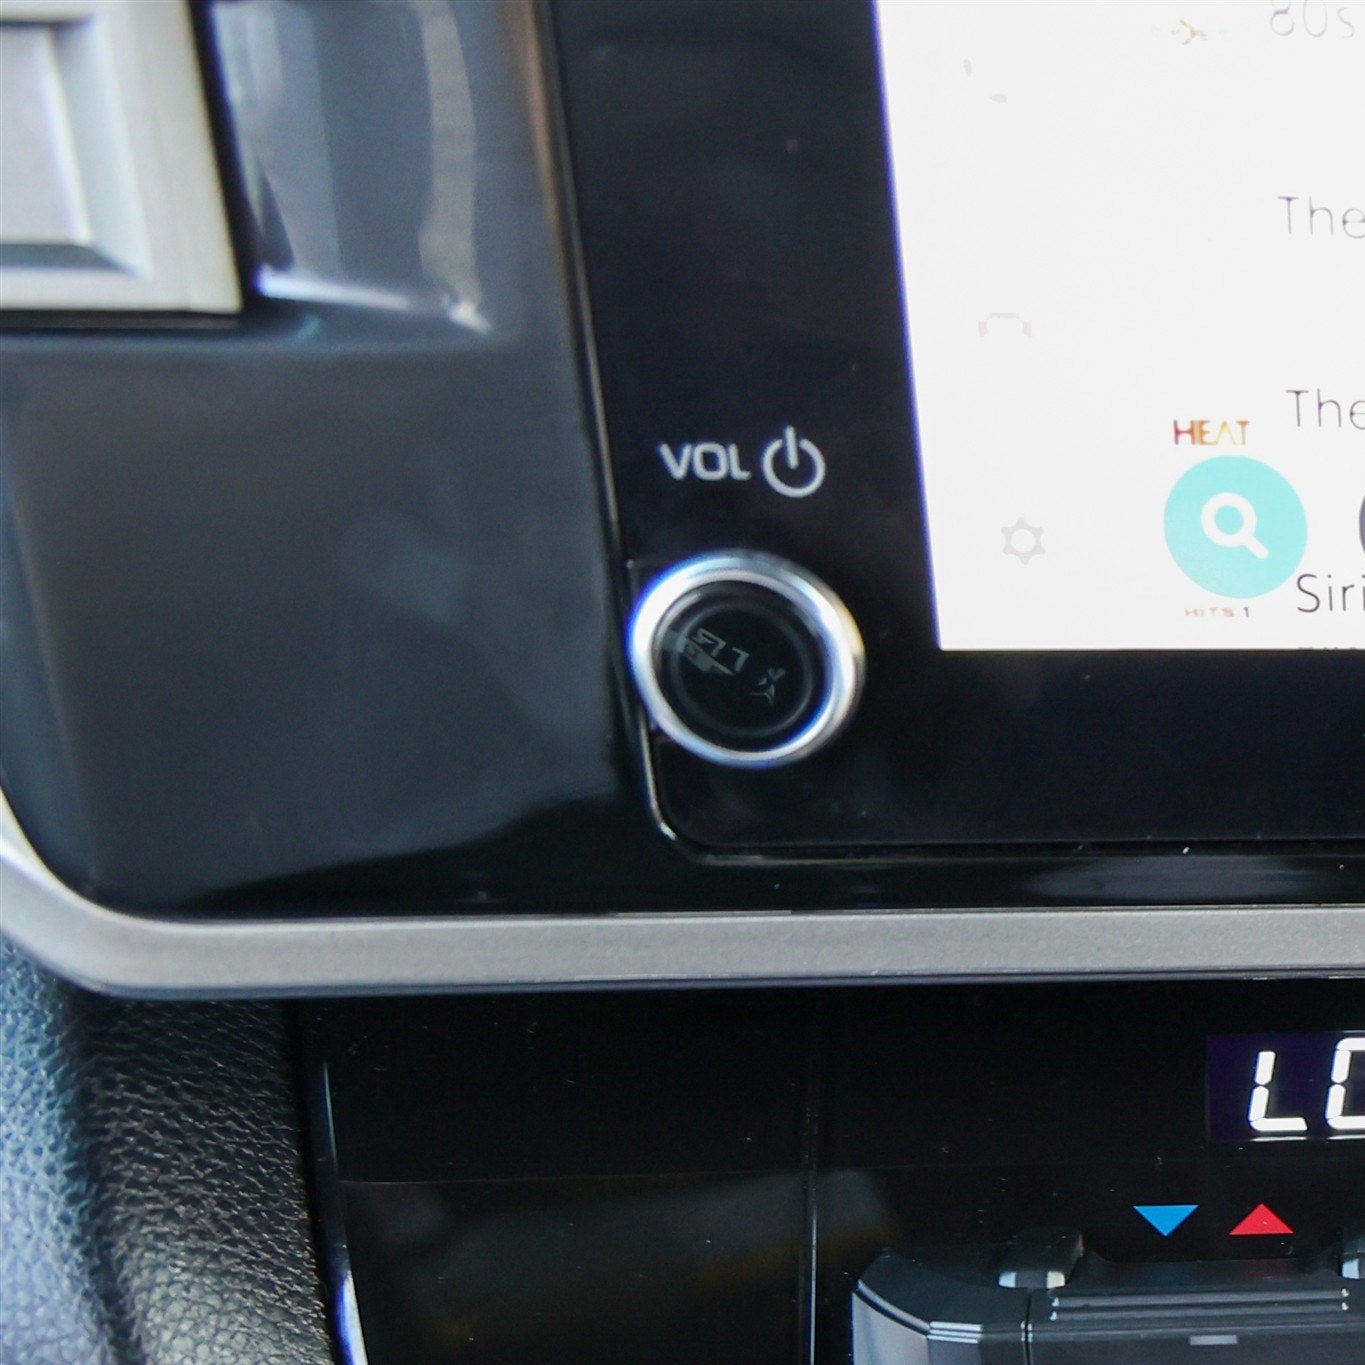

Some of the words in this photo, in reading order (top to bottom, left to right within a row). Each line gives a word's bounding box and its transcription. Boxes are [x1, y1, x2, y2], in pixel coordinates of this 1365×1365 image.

[1270, 0, 1355, 37] 80s
[1278, 196, 1365, 239] The
[1174, 420, 1248, 445] HEAT
[660, 443, 750, 480] VOL
